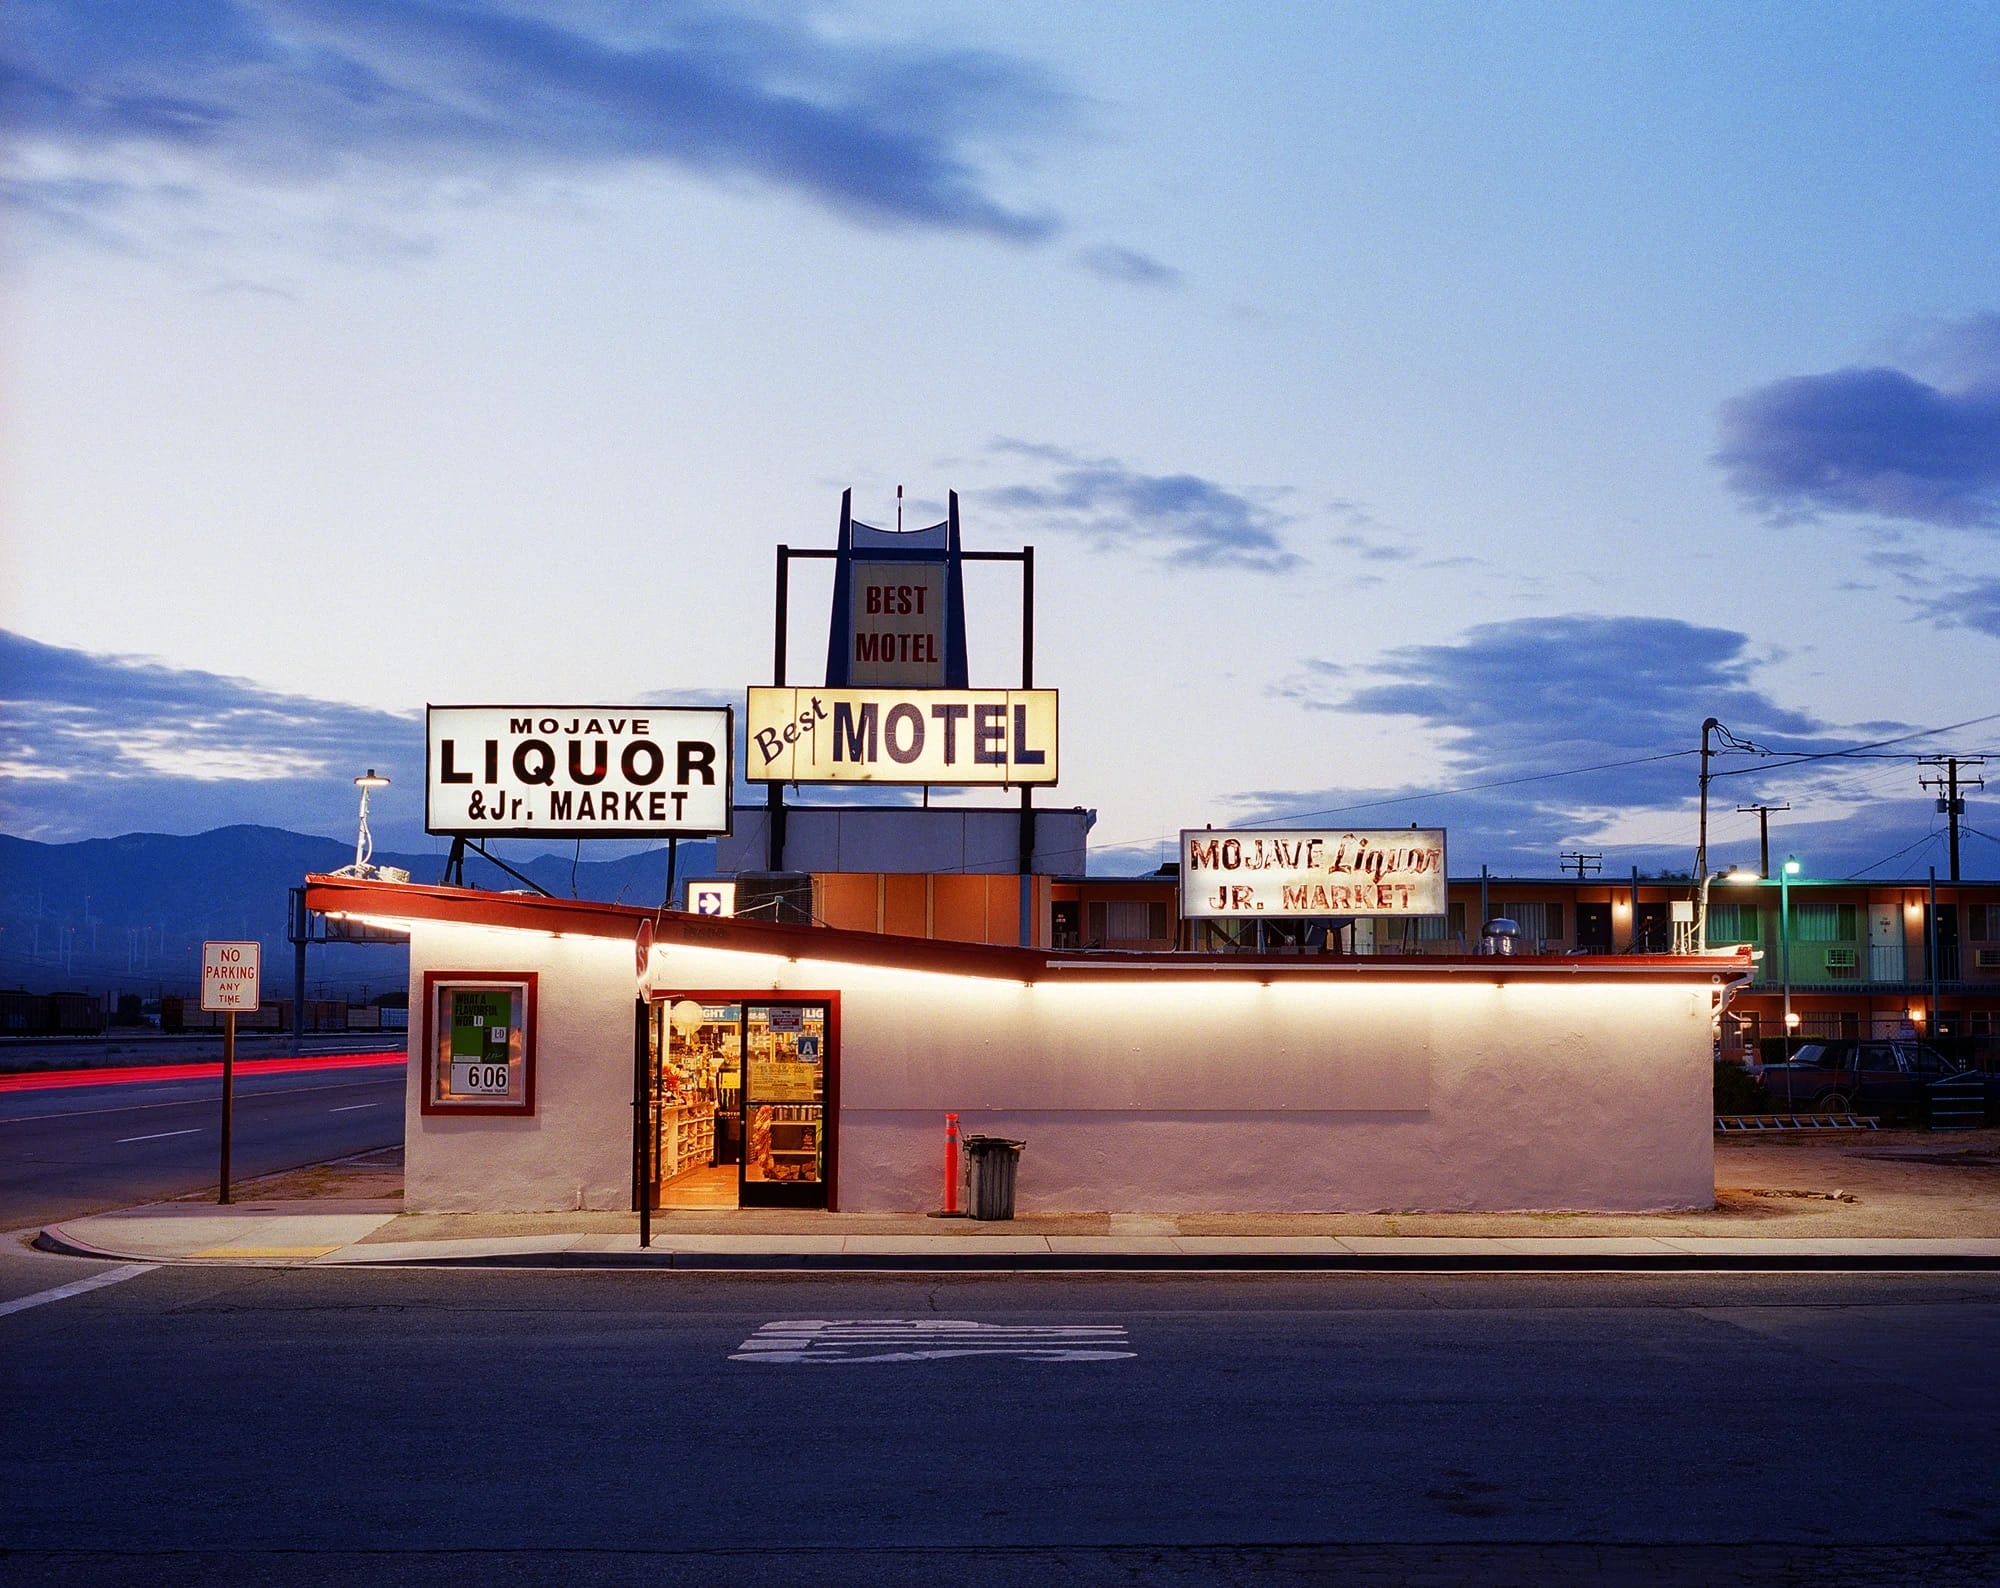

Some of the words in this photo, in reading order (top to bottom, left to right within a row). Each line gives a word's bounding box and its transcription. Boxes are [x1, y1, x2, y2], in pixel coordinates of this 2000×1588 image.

[866, 586, 927, 615] BEST
[856, 633, 938, 663] MOTEL
[510, 718, 650, 734] MOJAVE
[753, 696, 828, 765] Best
[833, 702, 1045, 765] MOTEL
[441, 739, 716, 786] LIQUOR
[468, 790, 533, 821] &Jr.
[550, 791, 688, 821] MARKET
[1190, 838, 1323, 870] MOJAVE
[1328, 834, 1442, 883] Liquor
[1209, 885, 1264, 911] JR.
[1283, 885, 1415, 910] MARKET
[221, 949, 240, 962] NO
[206, 966, 254, 979] PARKING
[220, 983, 240, 991] ANY
[219, 995, 240, 1003] TIME
[455, 993, 480, 1004] WHAT
[802, 1041, 814, 1055] A
[468, 1066, 507, 1088] 6.06
